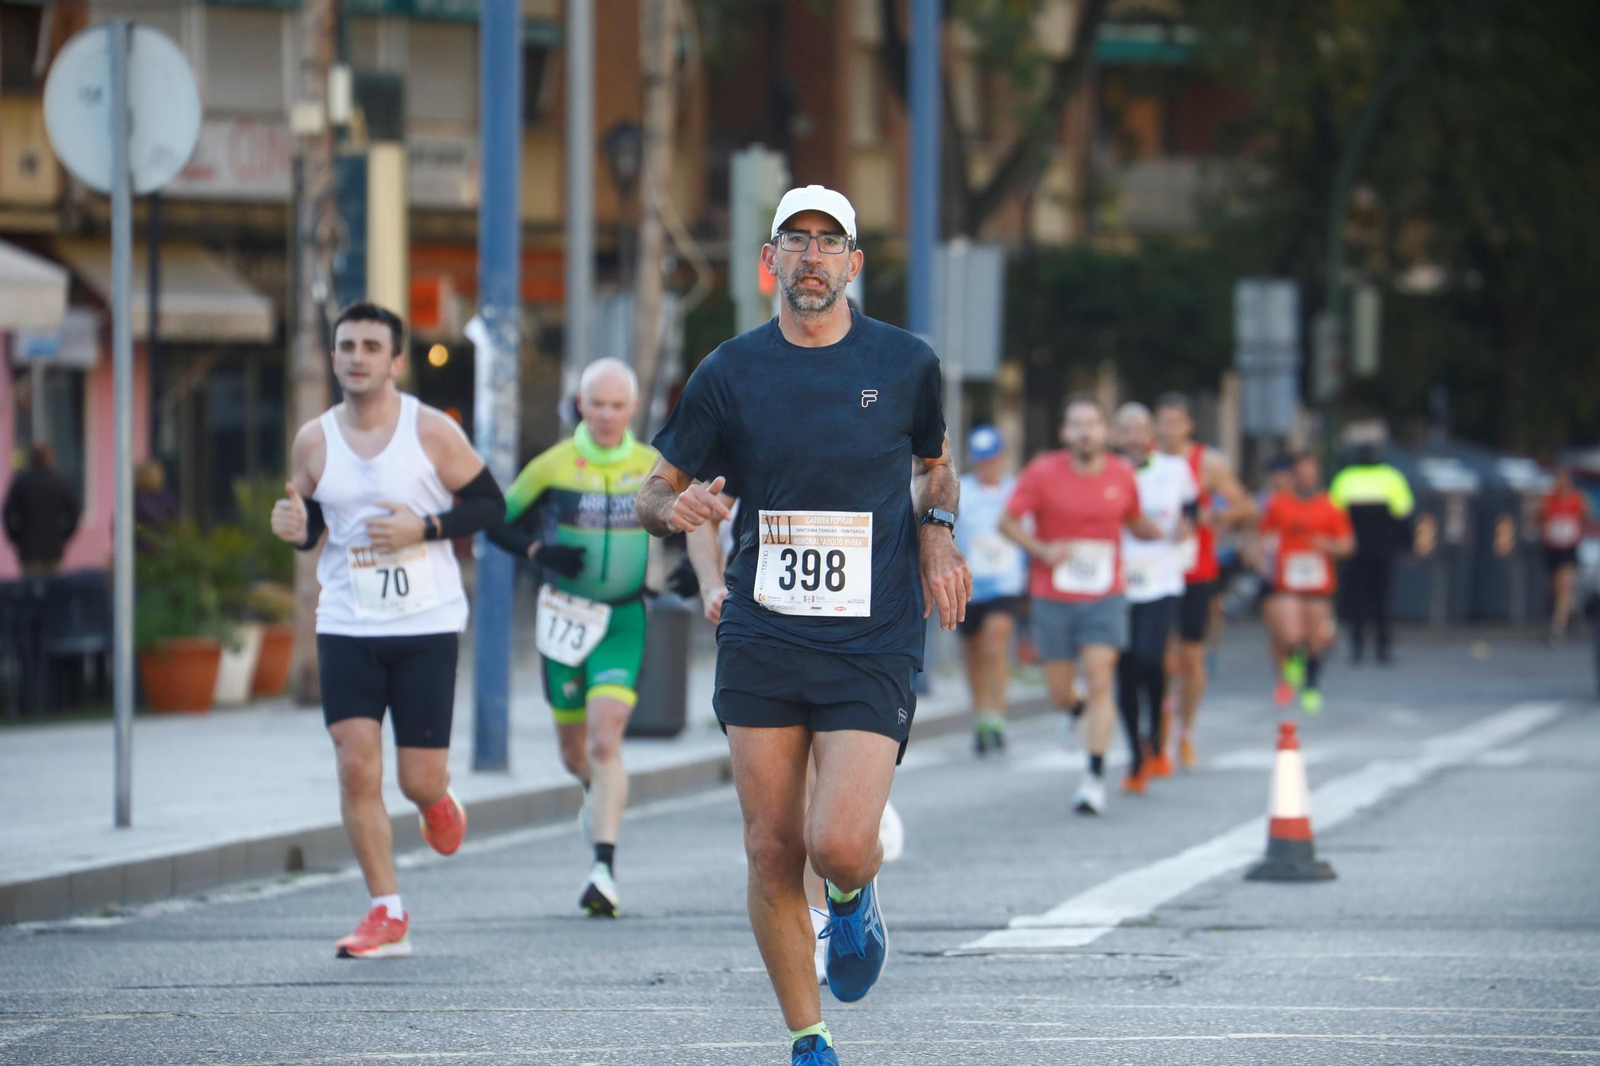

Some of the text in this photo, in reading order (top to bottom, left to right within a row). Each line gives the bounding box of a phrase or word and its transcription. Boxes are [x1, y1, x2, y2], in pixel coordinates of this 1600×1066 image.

[764, 515, 793, 545] XLI
[806, 516, 853, 525] CARRERA POPULAR
[794, 537, 819, 545] MEMORIAL
[375, 567, 409, 599] 70
[778, 548, 846, 592] 398
[547, 613, 586, 651] 173
